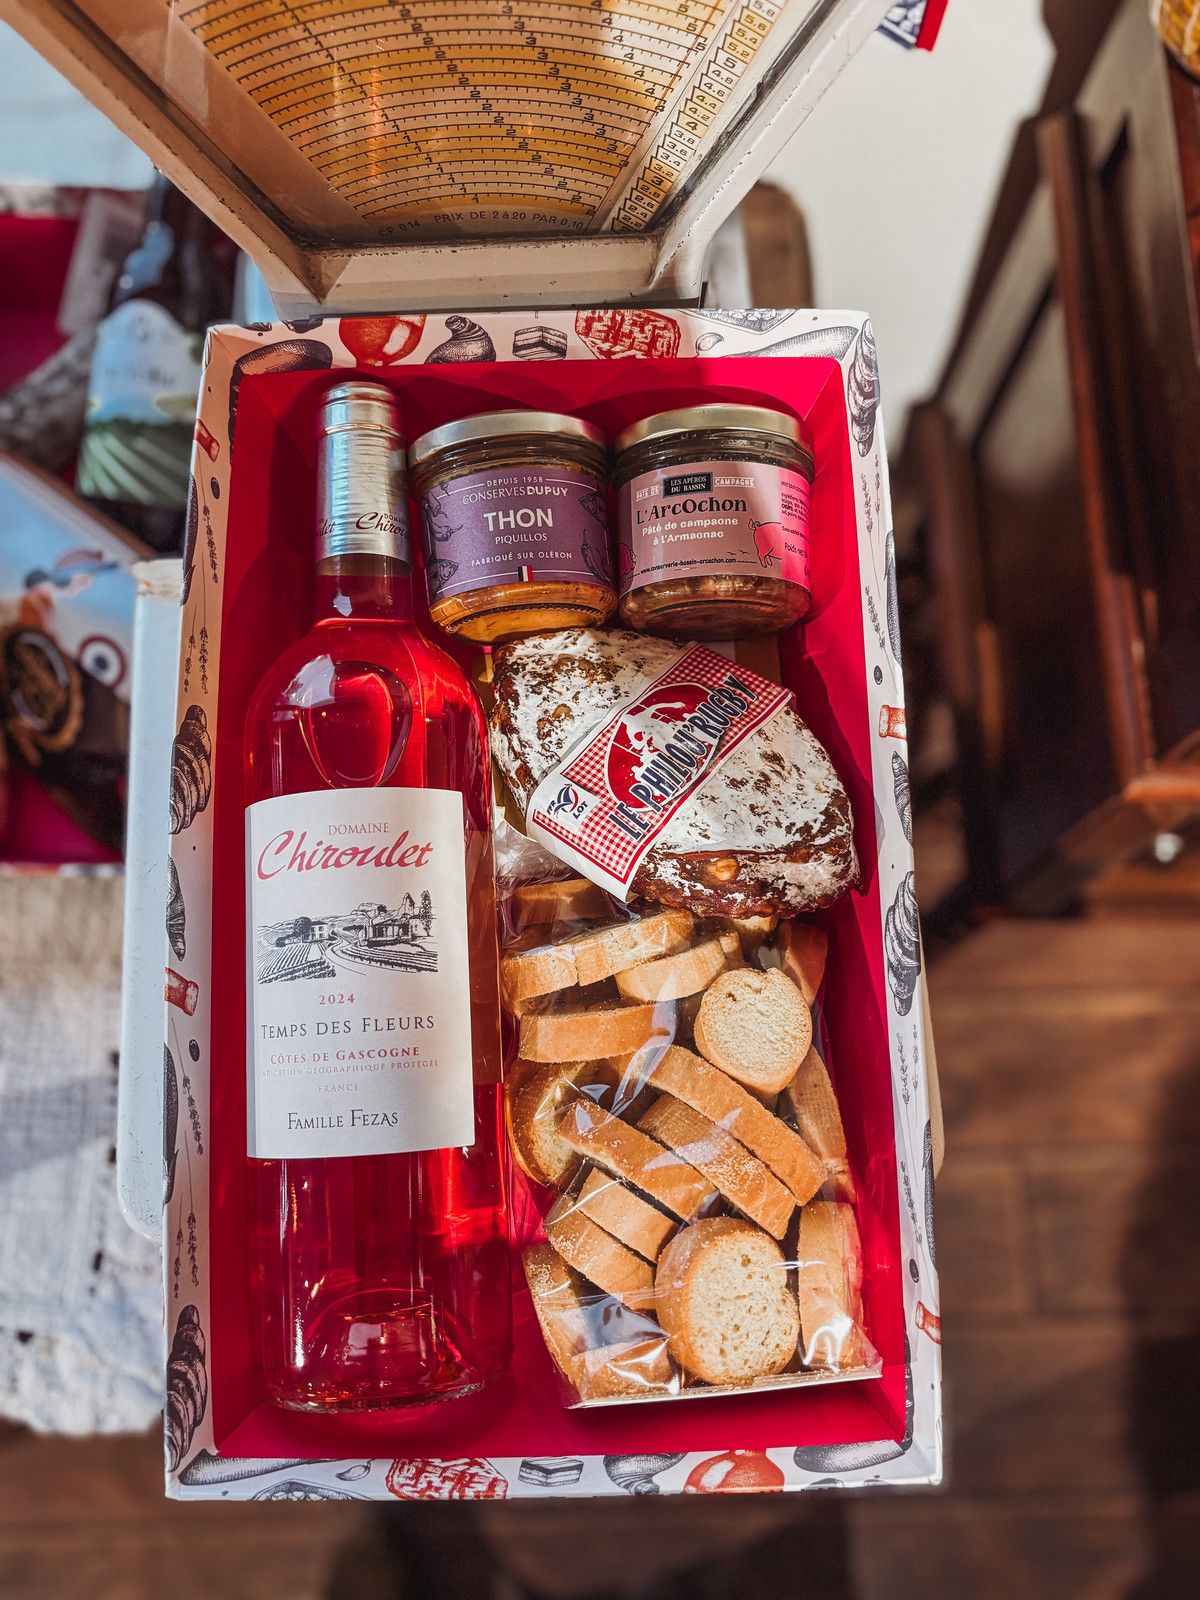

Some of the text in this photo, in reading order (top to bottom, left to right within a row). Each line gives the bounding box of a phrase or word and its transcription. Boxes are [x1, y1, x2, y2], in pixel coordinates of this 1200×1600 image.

[502, 5, 513, 15] 3
[591, 0, 603, 8] 4
[678, 4, 689, 14] 5
[514, 21, 526, 31] 3
[602, 17, 614, 26] 4
[745, 14, 767, 32] 5.6
[687, 23, 698, 33] 5
[525, 36, 537, 46] 3
[613, 35, 625, 44] 4
[736, 27, 758, 45] 5.4
[696, 43, 707, 52] 5
[727, 42, 750, 59] 5.2
[537, 51, 549, 61] 3
[624, 53, 635, 62] 4
[723, 57, 737, 70] 5
[549, 66, 560, 76] 3
[634, 70, 646, 79] 4
[712, 69, 734, 85] 4.8
[560, 82, 572, 91] 3
[645, 87, 656, 96] 4
[704, 82, 726, 98] 4.6
[572, 97, 583, 106] 3
[695, 94, 718, 110] 4.4
[655, 105, 666, 114] 4
[688, 106, 711, 121] 4.2
[584, 112, 595, 121] 3
[596, 127, 607, 137] 3
[685, 121, 699, 132] 4
[674, 129, 696, 145] 3.8
[607, 142, 618, 153] 3
[666, 140, 688, 157] 3.6
[619, 158, 630, 168] 3
[660, 152, 682, 167] 3.4
[653, 162, 675, 177] 3.2
[651, 175, 664, 187] 3
[640, 183, 661, 199] 2.8
[634, 194, 656, 209] 2.6
[433, 212, 465, 224] PRIX
[469, 210, 486, 220] DE
[492, 210, 500, 219] 2
[512, 210, 527, 220] 20
[532, 211, 557, 224] PAR
[627, 206, 648, 219] 2.4
[621, 214, 643, 229] 2.2
[486, 477, 519, 487] DEPUIS
[683, 482, 706, 492] BASSIN
[715, 478, 754, 488] CAMPAGNE
[483, 508, 554, 533] THON
[641, 522, 662, 537] Pâté
[664, 520, 678, 531] de
[495, 532, 548, 545] PIQUILLOS
[471, 550, 573, 568] FABRIQUÉ SUR OLÉRON
[572, 800, 588, 820] LOT
[608, 801, 653, 841] LE
[327, 822, 390, 836] DOMAINE
[256, 829, 434, 881] Chiroulet
[318, 993, 356, 1005] 2024
[261, 1015, 435, 1040] TEMPS DES FLEURS
[312, 1052, 330, 1063] DE
[335, 1046, 421, 1062] GASCOGNE
[317, 1082, 361, 1093] FRANCE
[287, 1108, 399, 1131] FAMILLE FEZAS
